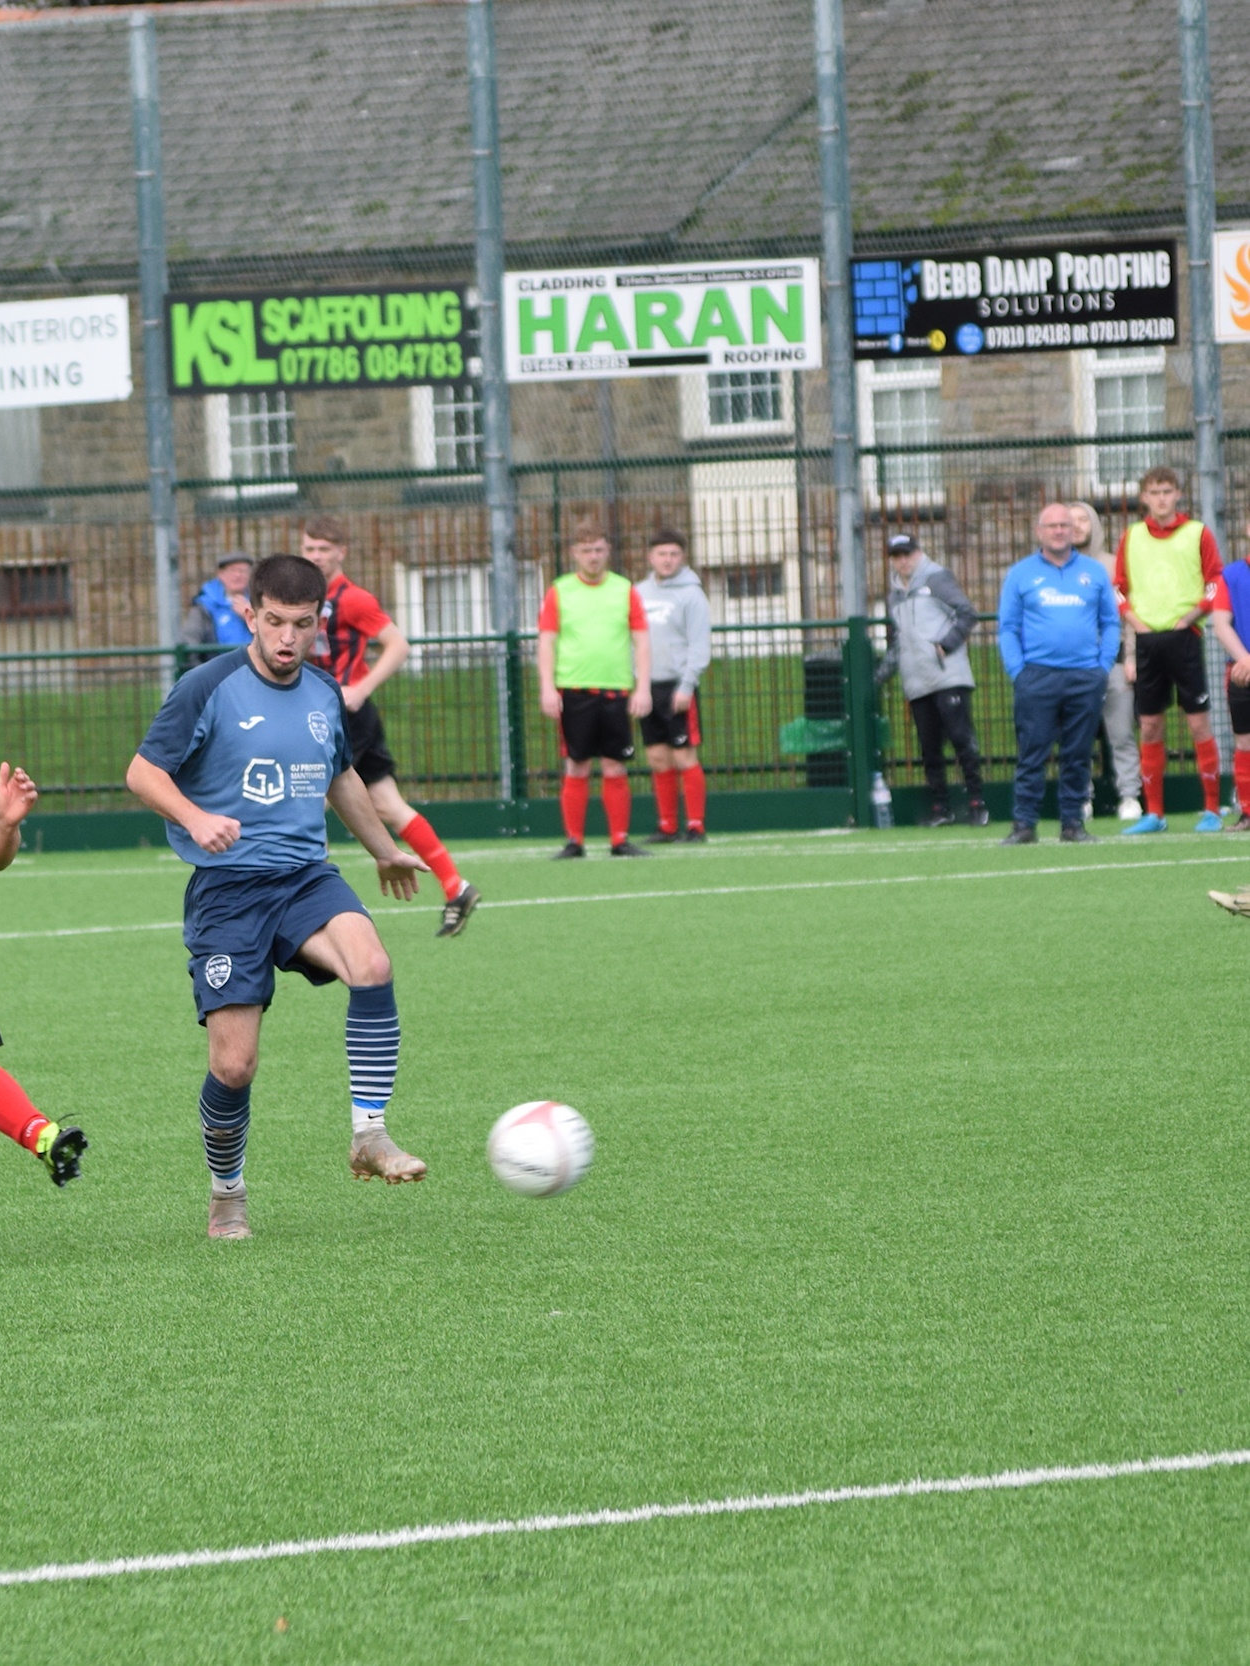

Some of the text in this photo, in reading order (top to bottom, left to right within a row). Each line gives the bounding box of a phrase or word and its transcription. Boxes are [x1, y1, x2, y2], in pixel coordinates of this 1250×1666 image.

[519, 275, 607, 292] CLADDING
[922, 251, 1171, 300] BEBB DAMP PROOFING
[261, 291, 461, 344] SCAFFOLDING
[519, 285, 804, 354] HARAN
[978, 292, 1116, 318] SOLUTIONS
[171, 300, 278, 387] KSL
[986, 326, 1025, 348] 07810
[1073, 324, 1088, 342] OR
[1090, 320, 1128, 341] 07810
[279, 342, 463, 383] 07786 084783
[724, 350, 806, 365] ROOFING
